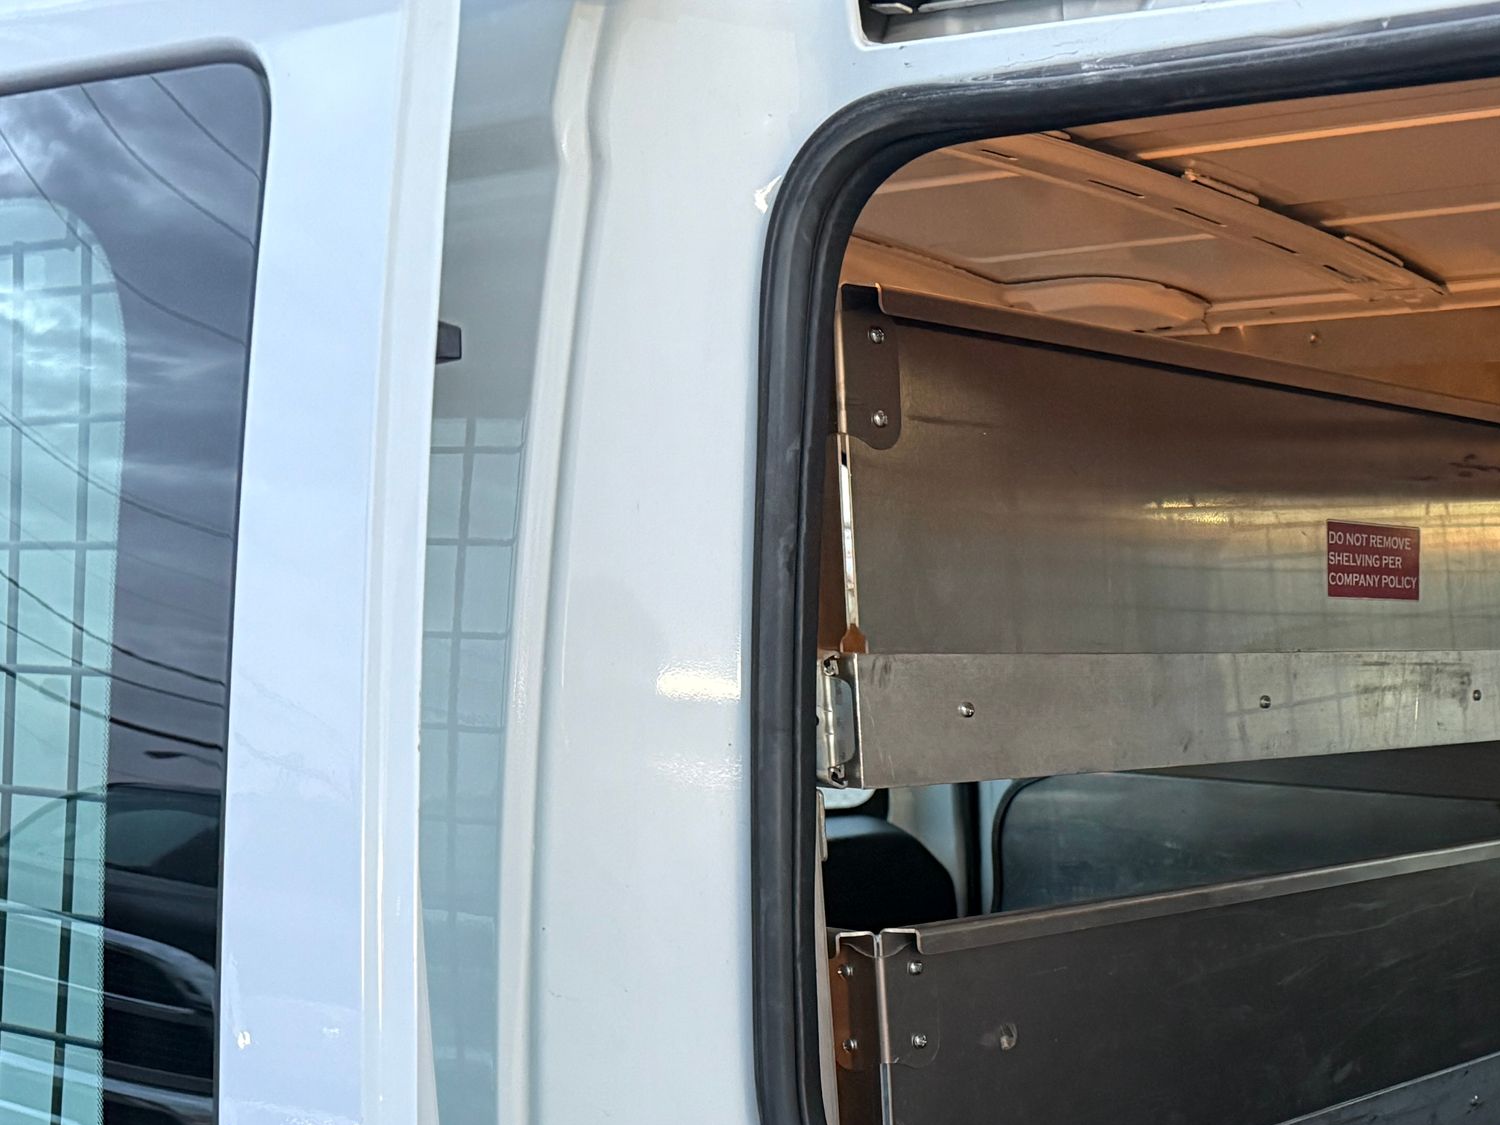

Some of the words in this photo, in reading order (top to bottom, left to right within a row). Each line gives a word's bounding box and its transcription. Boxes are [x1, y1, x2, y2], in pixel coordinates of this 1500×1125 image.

[1329, 531, 1344, 544] DO
[1346, 533, 1368, 546] NOT
[1370, 535, 1411, 550] REMOVE
[1329, 552, 1380, 567] SHELVING
[1382, 555, 1402, 568] PER
[1329, 572, 1379, 587] COMPANY
[1382, 575, 1417, 589] POLICY
